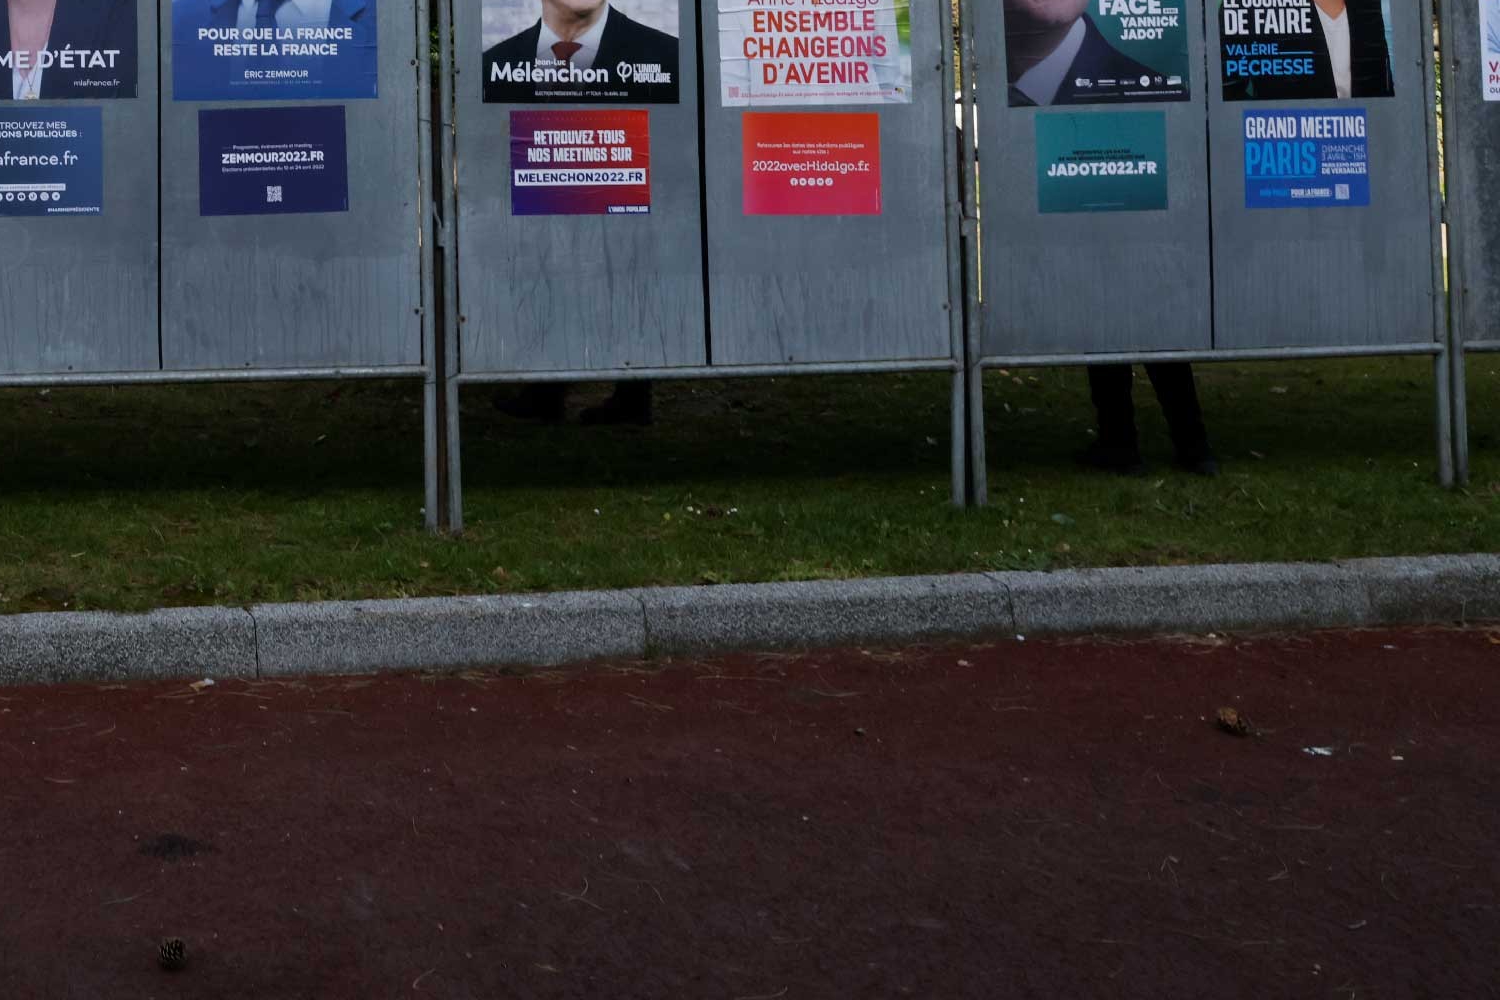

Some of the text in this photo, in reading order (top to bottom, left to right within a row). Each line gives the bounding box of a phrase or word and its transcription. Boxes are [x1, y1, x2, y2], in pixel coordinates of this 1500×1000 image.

[753, 10, 876, 33] ENSEMBLE
[1120, 16, 1178, 28] YANNICK
[1223, 8, 1312, 36] DE FAIRE
[198, 27, 353, 40] POUR QUE LA FRANCE
[1120, 28, 1164, 40] JADOT
[213, 43, 338, 56] RESTE LA FRANCE
[742, 35, 887, 59] CHANGEONS
[1225, 41, 1279, 56] VALÉRIE
[37, 44, 120, 69] D'ÉTAT
[534, 58, 567, 66] Jean-Luc
[490, 61, 609, 83] Mélenchon
[762, 61, 870, 85] D'AVENIR
[1226, 56, 1315, 76] PÉCRESSE
[265, 70, 309, 78] ZEMMOUR
[632, 72, 671, 83] POPULAIRE
[73, 79, 120, 87] mlafrance.fr
[46, 121, 67, 129] MES
[1245, 115, 1365, 139] GRAND MEETING
[24, 130, 78, 138] PUBLIQUES
[533, 129, 626, 145] RETROUVEZ TOUS
[527, 147, 632, 162] NOS MEETINGS SUR
[1321, 144, 1365, 153] DIMANCHE
[221, 150, 324, 164] ZEMMOUR2022.FR
[1245, 141, 1317, 176] PARIS
[752, 160, 870, 175] 2022avecHidalgo.fr
[1047, 161, 1157, 177] JADOT2022.FR
[1321, 167, 1331, 175] DE
[518, 171, 643, 183] MELENCHON2022.FR
